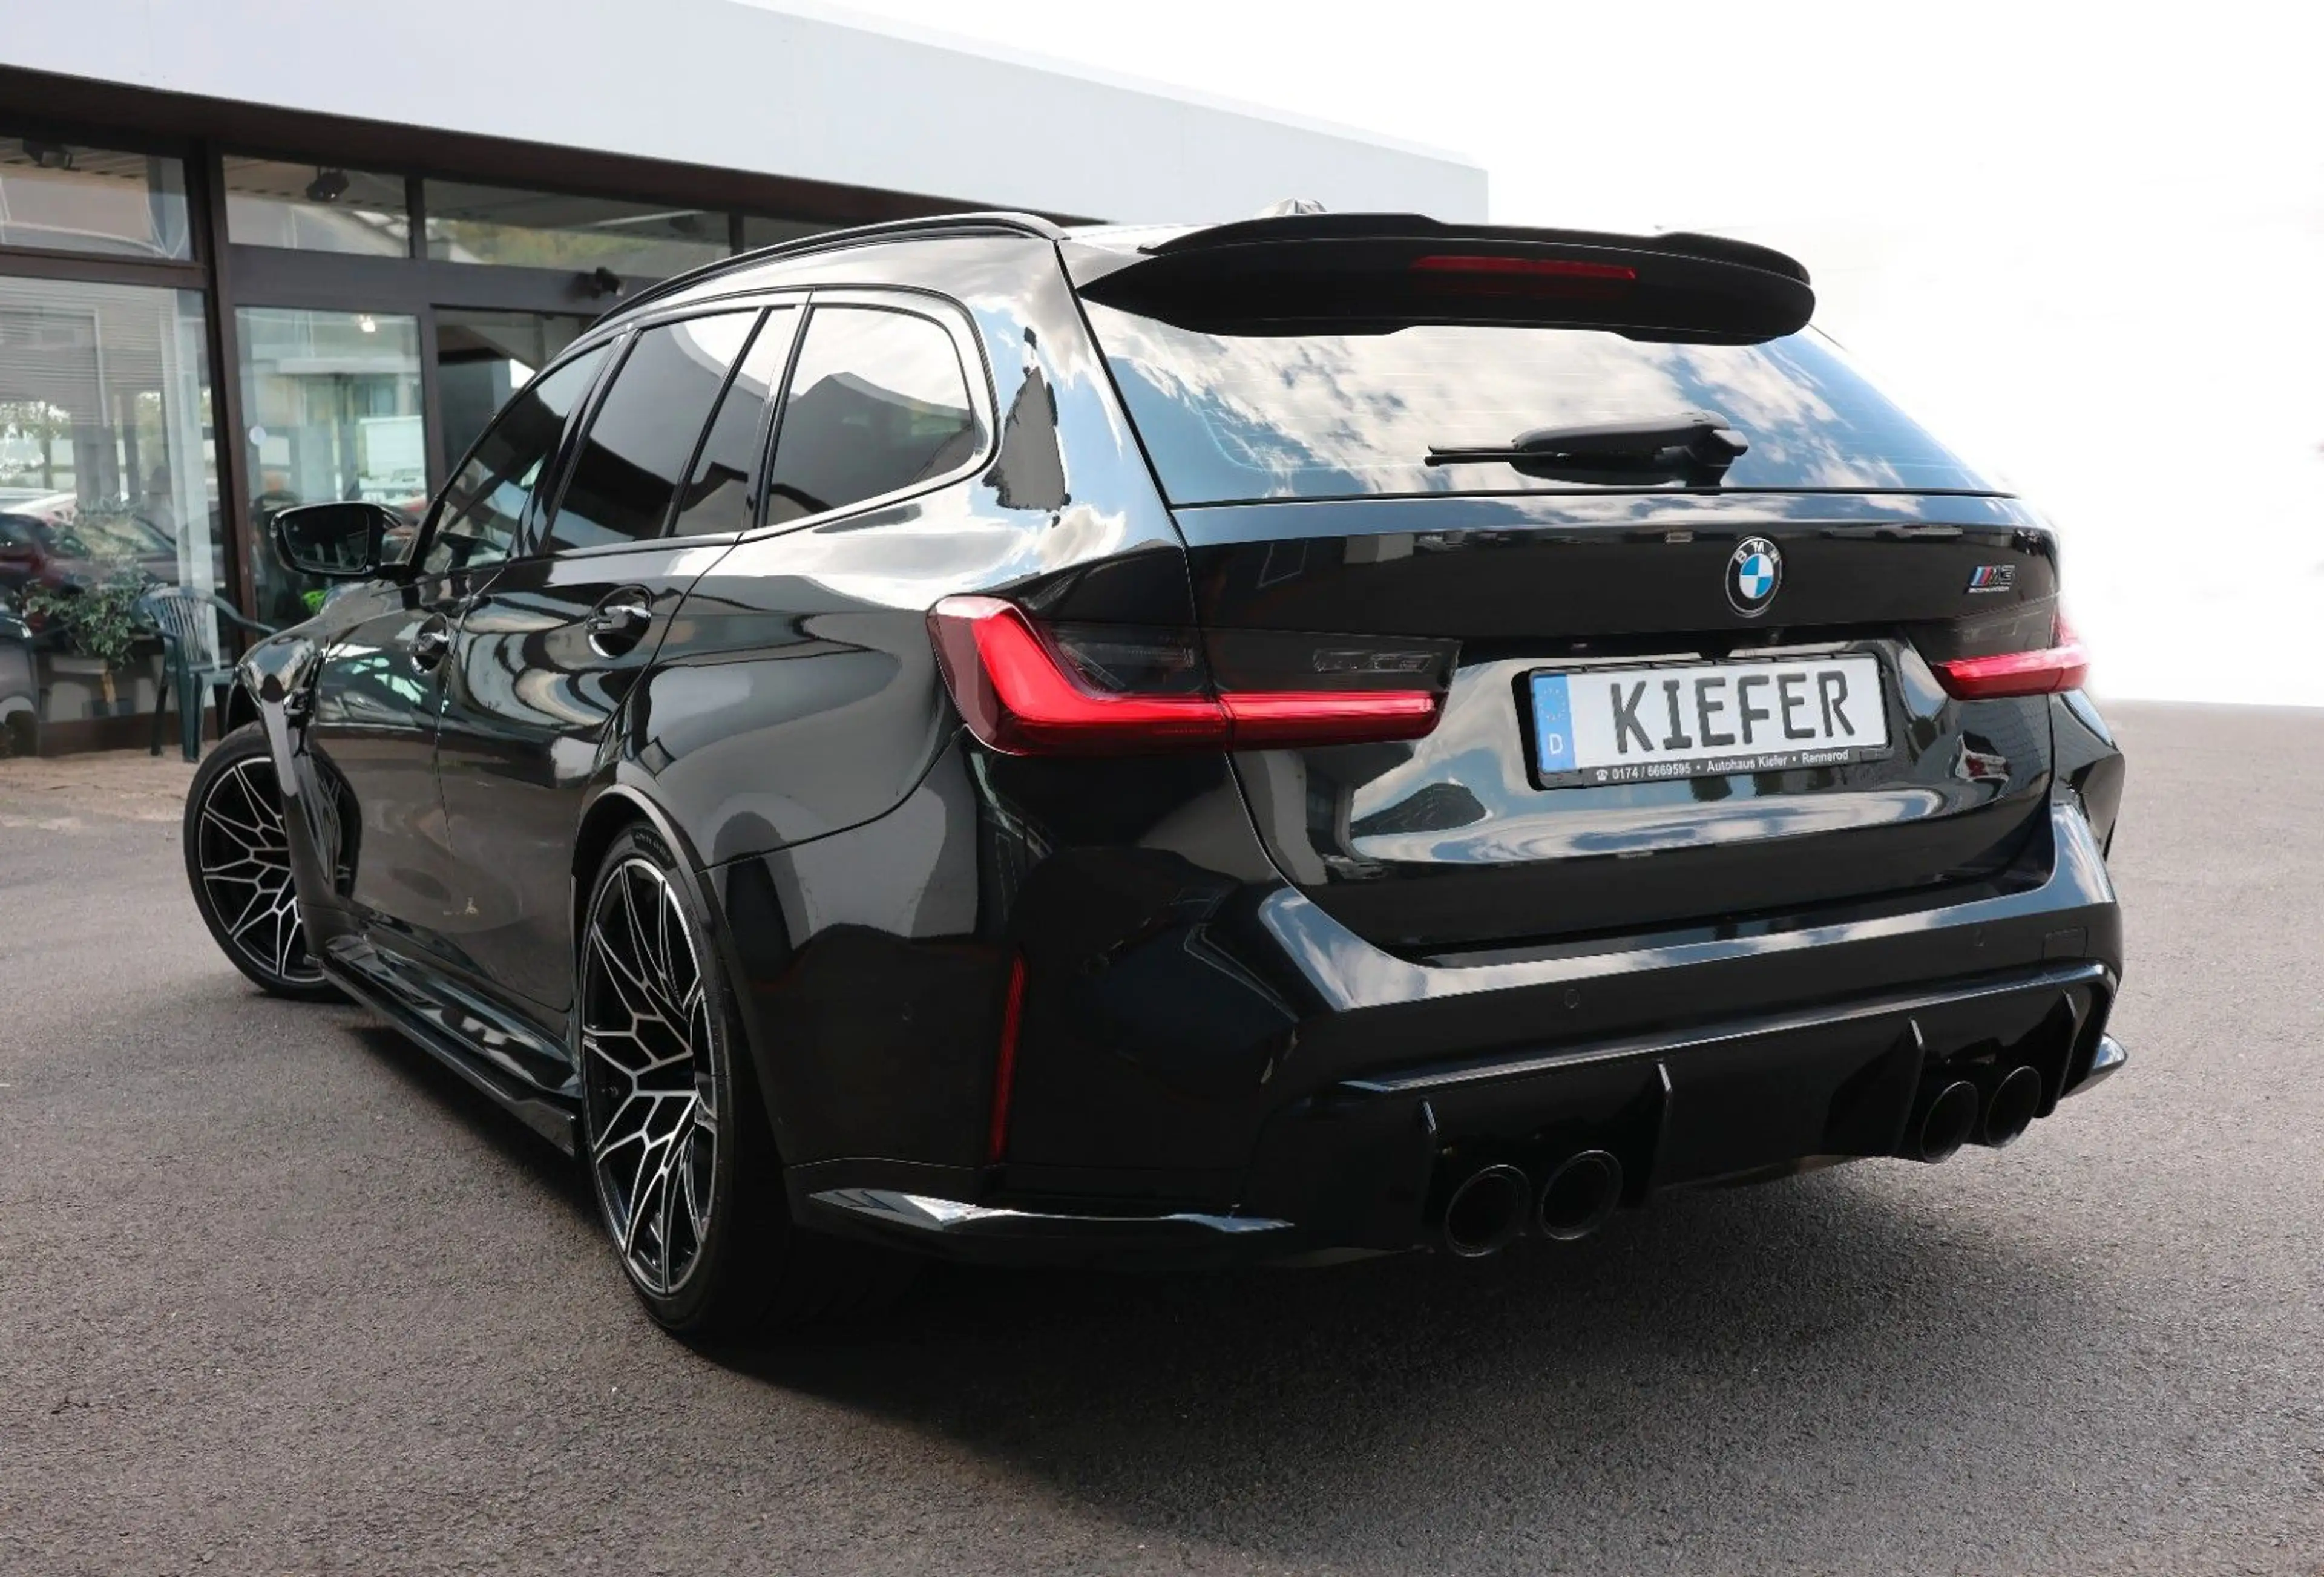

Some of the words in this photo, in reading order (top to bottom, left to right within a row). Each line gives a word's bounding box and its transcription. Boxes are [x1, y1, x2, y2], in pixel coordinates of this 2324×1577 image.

[1735, 541, 1780, 564] BMW
[1610, 670, 1856, 754] KIEFER
[1549, 733, 1564, 755] D
[1612, 767, 1639, 780] 0174
[1706, 759, 1755, 773] Autohaus
[1758, 755, 1788, 768] Kiefer
[1802, 749, 1849, 764] Rennerod
